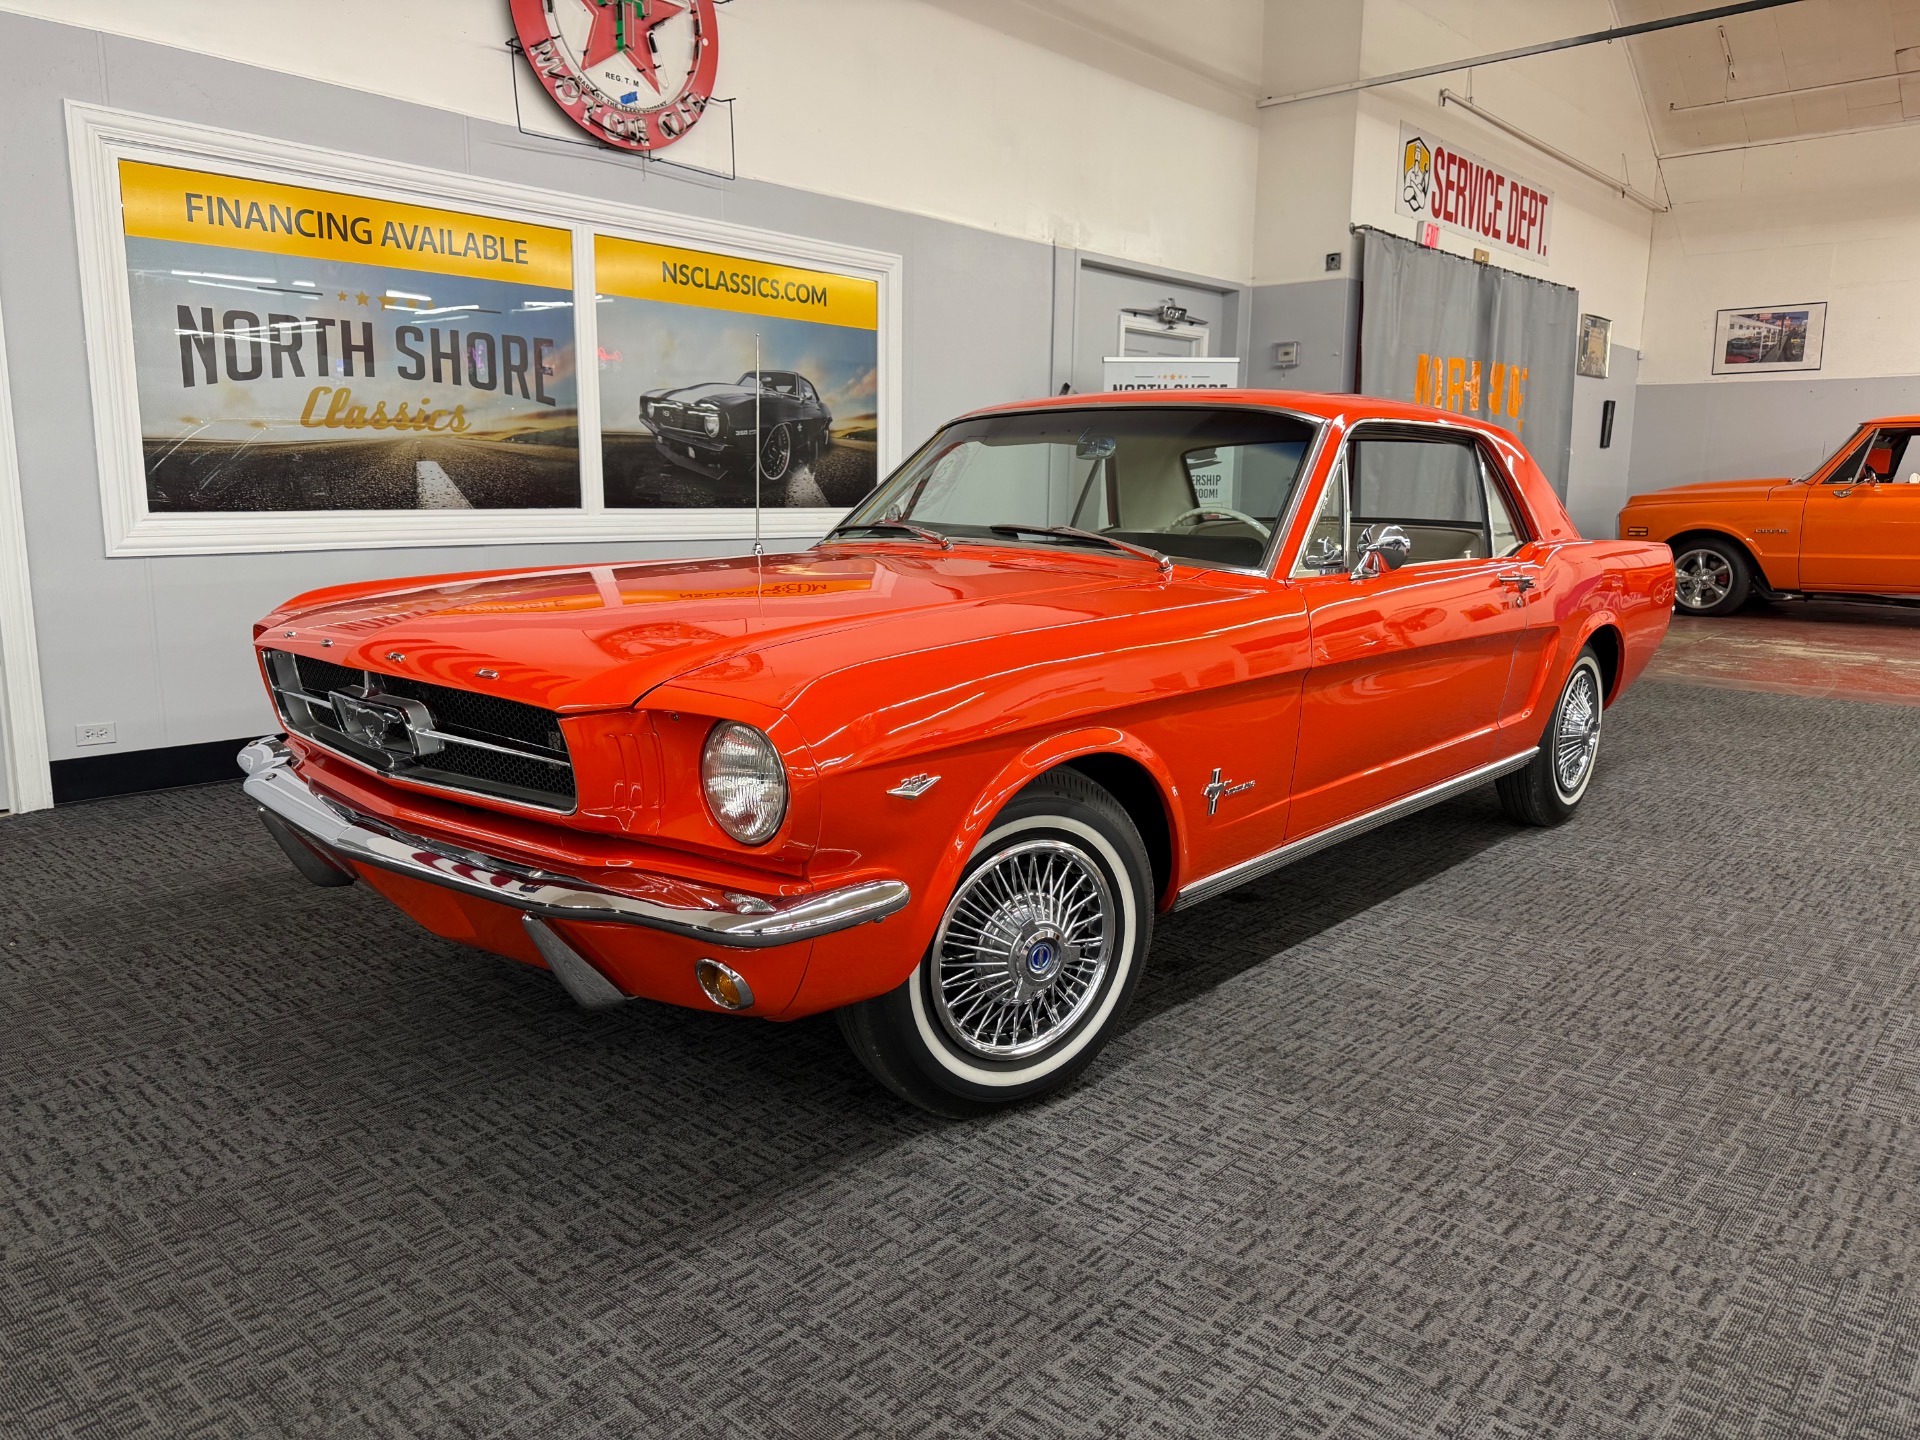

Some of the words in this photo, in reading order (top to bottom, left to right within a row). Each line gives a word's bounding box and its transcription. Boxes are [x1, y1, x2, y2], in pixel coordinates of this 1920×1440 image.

[184, 192, 373, 245] FINANCING
[381, 220, 530, 266] AVAILABLE
[1431, 146, 1505, 240] SERVICE
[1506, 180, 1549, 257] DEPT.
[661, 260, 828, 307] NSCLASSICS.COM
[176, 304, 376, 389] NORTH
[394, 324, 557, 408] SHORE
[300, 386, 473, 433] Classics
